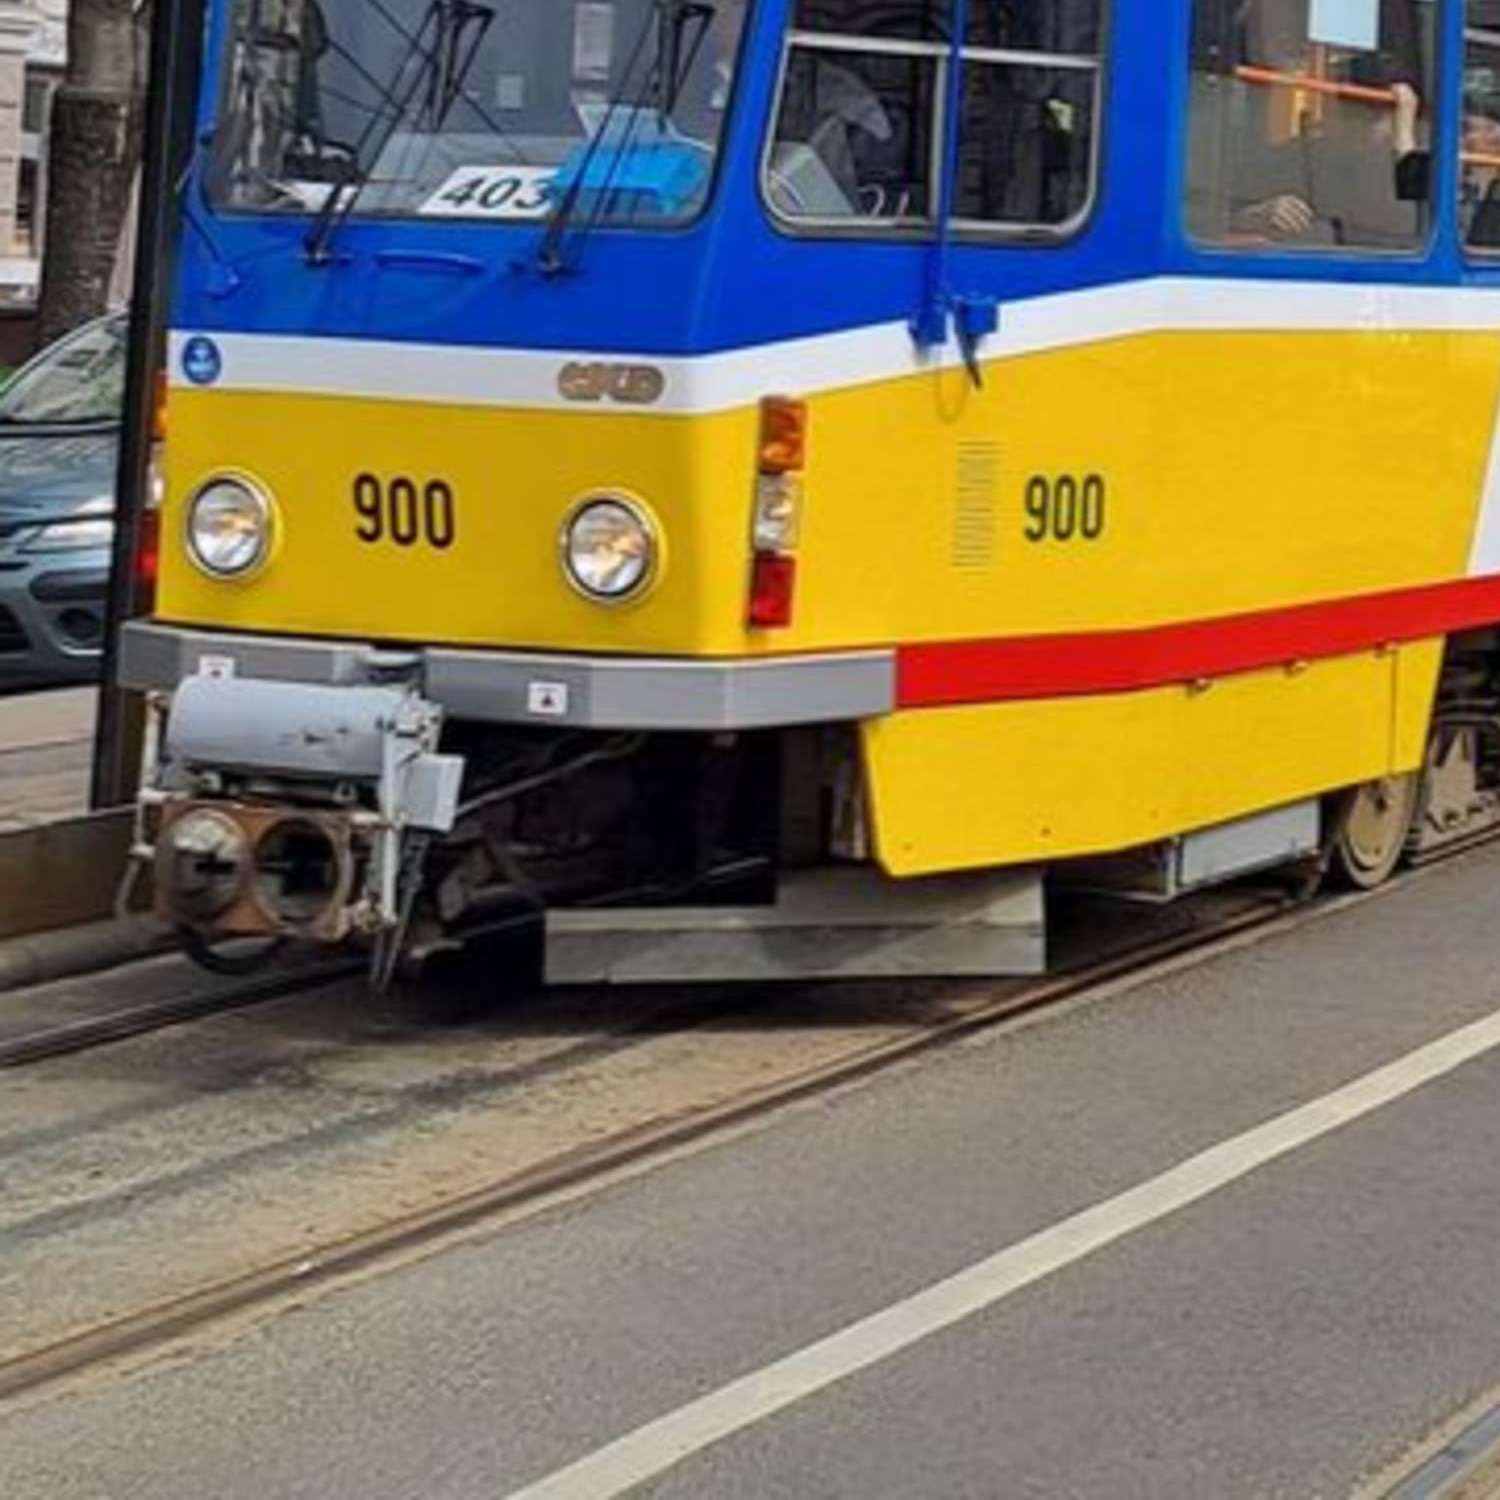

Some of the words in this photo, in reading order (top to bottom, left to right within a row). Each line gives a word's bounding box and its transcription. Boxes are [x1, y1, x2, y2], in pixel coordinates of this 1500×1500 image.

[439, 173, 554, 209] 403
[353, 472, 456, 551] 900
[1024, 474, 1105, 543] 900
